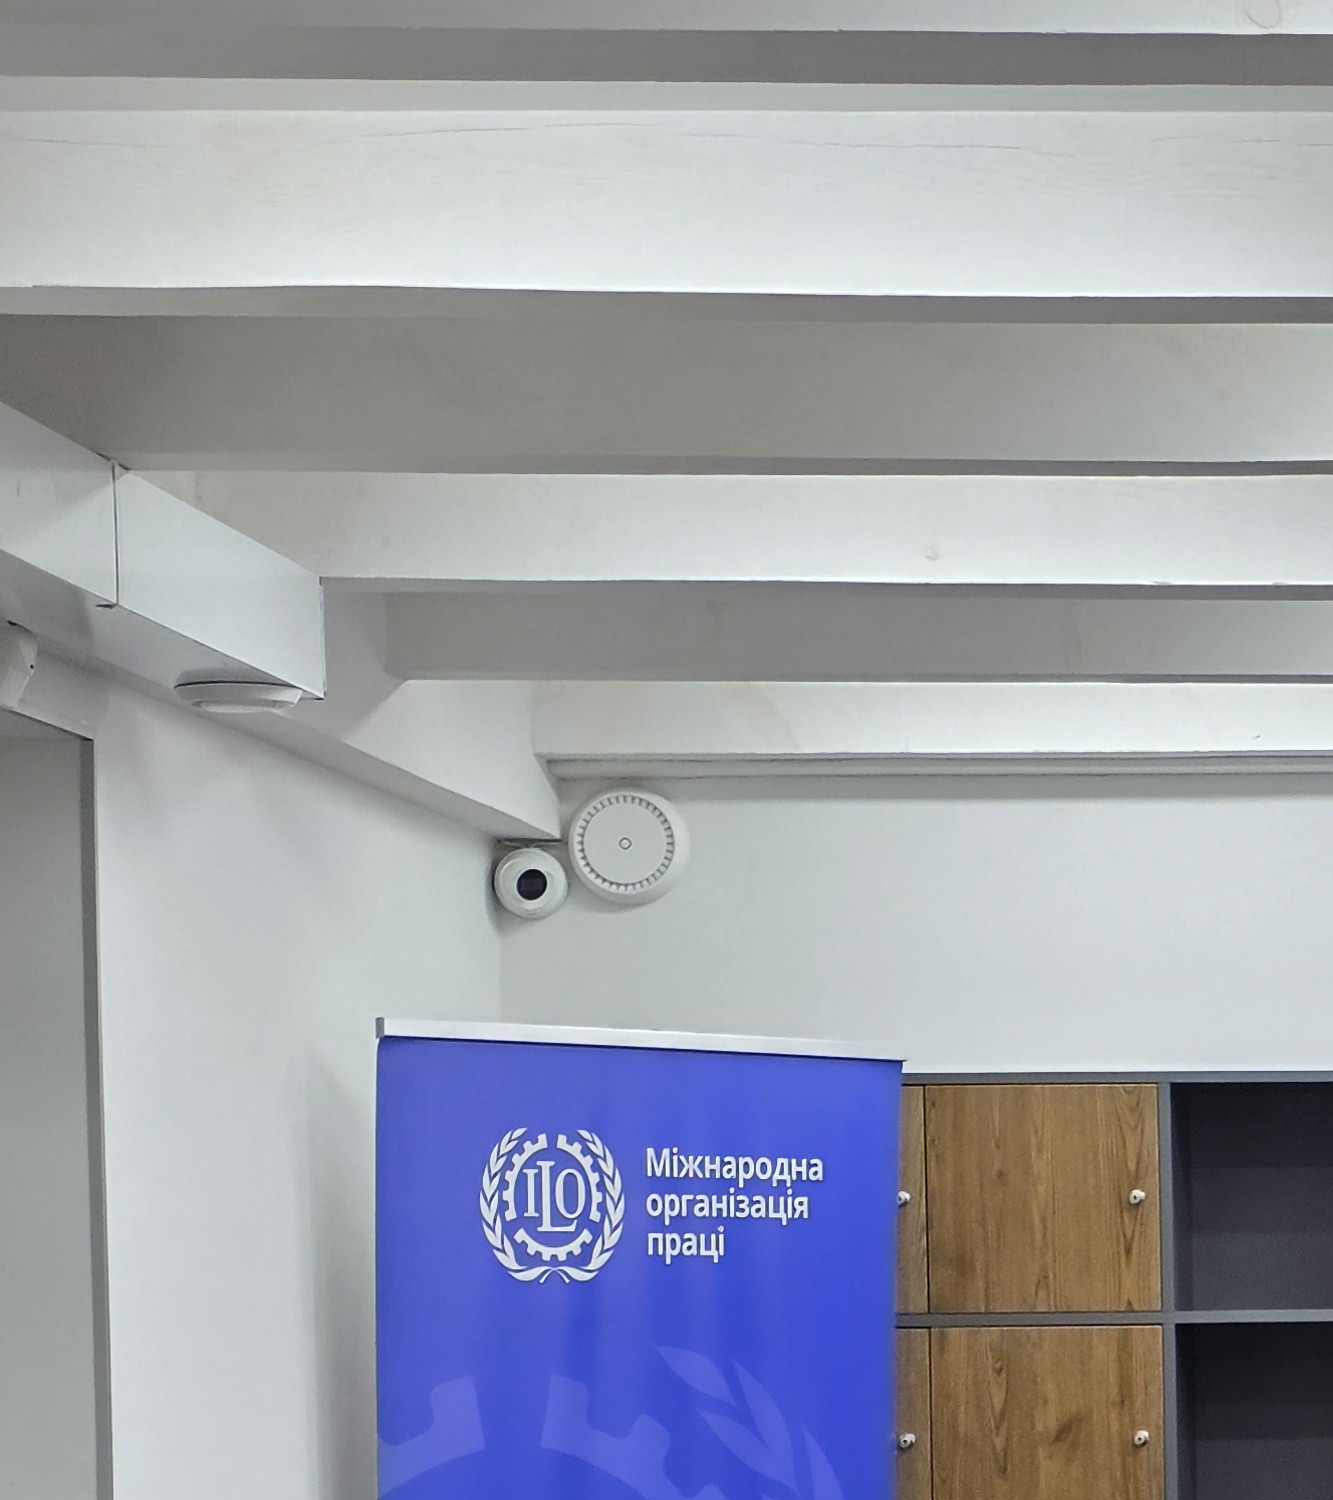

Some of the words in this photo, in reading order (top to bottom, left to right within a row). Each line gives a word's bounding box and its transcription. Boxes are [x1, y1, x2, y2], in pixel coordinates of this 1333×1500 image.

[646, 1147, 823, 1188] Міжнародна
[522, 1160, 586, 1232] ILO
[646, 1187, 809, 1226] організація
[647, 1225, 725, 1265] праці
